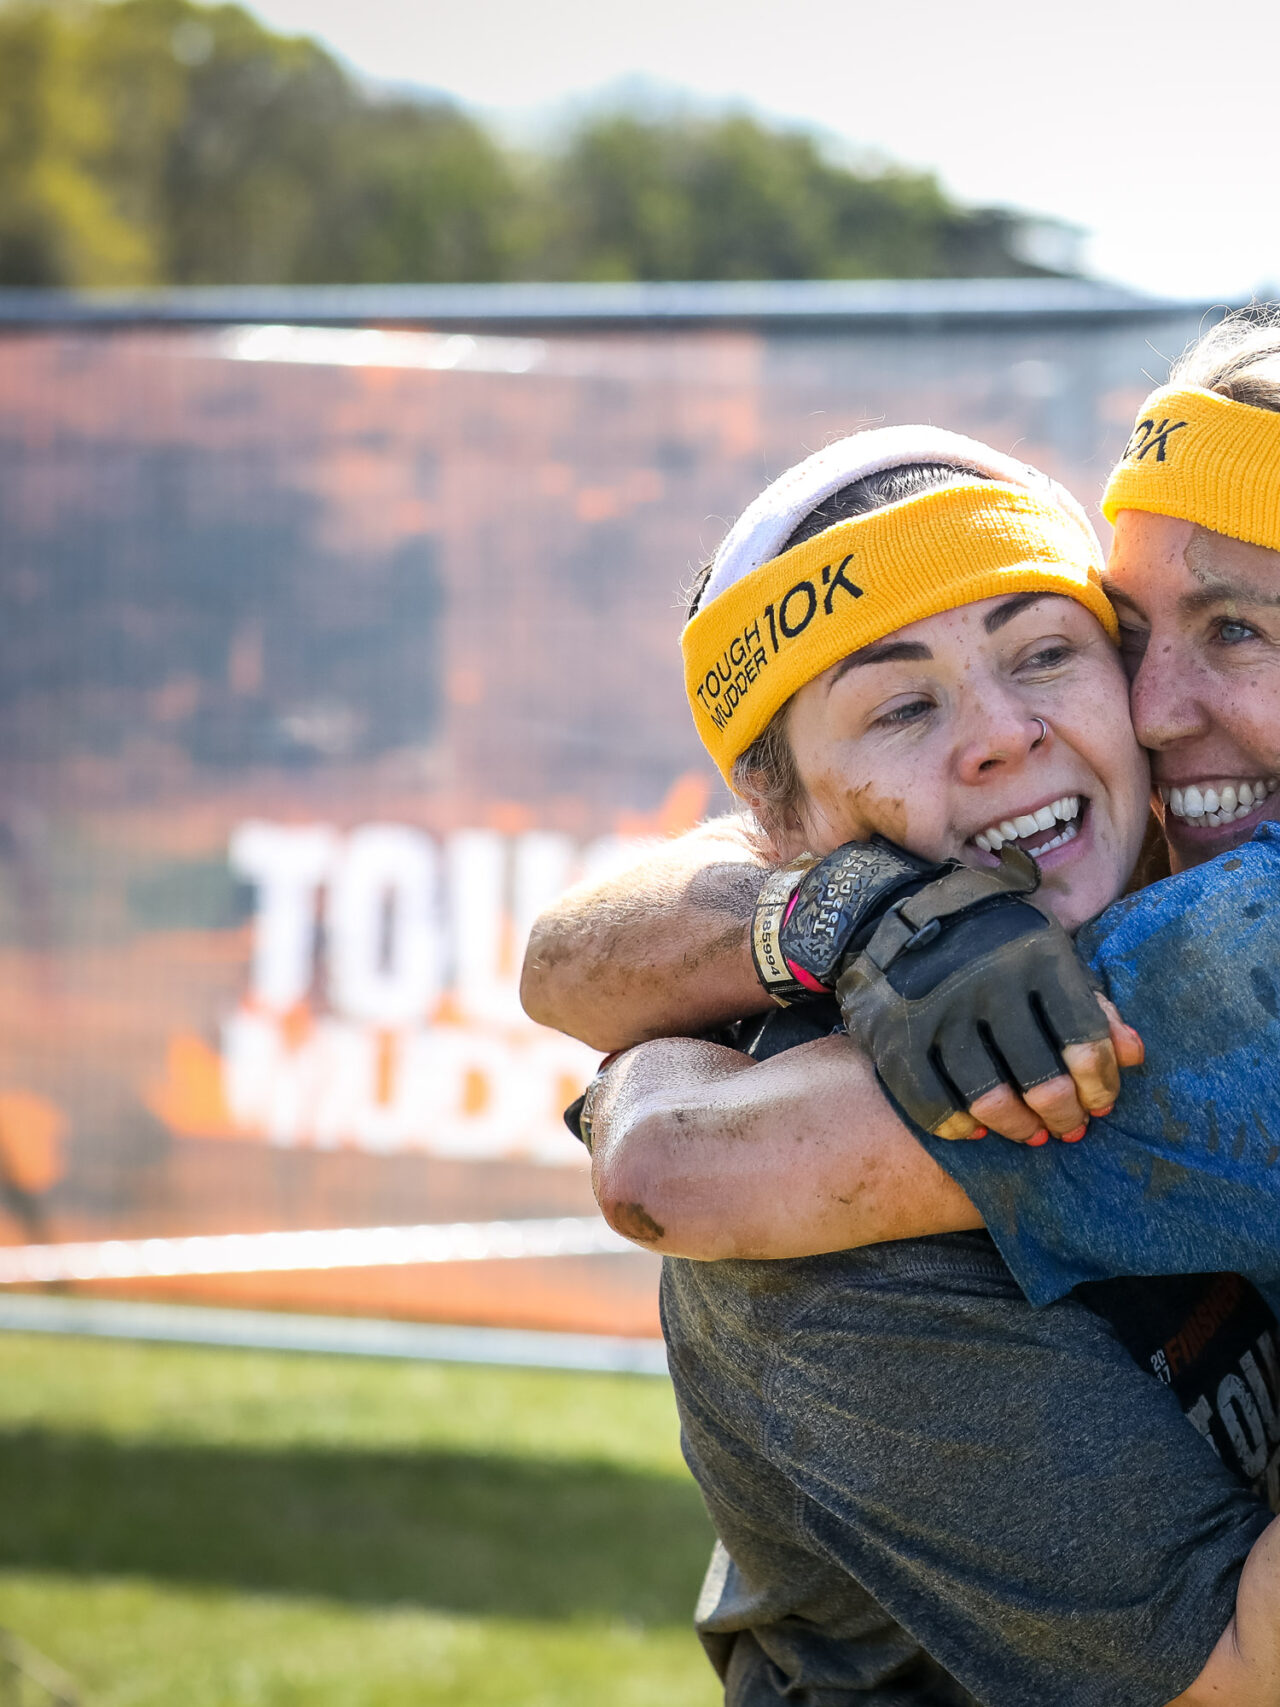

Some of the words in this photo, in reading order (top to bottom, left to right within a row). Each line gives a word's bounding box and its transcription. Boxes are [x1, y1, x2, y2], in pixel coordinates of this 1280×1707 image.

[1122, 418, 1188, 462] 0K
[763, 553, 864, 654] 10K
[697, 617, 761, 710] TOUGH
[711, 646, 768, 733] MUDDER
[229, 819, 605, 1027] TOU
